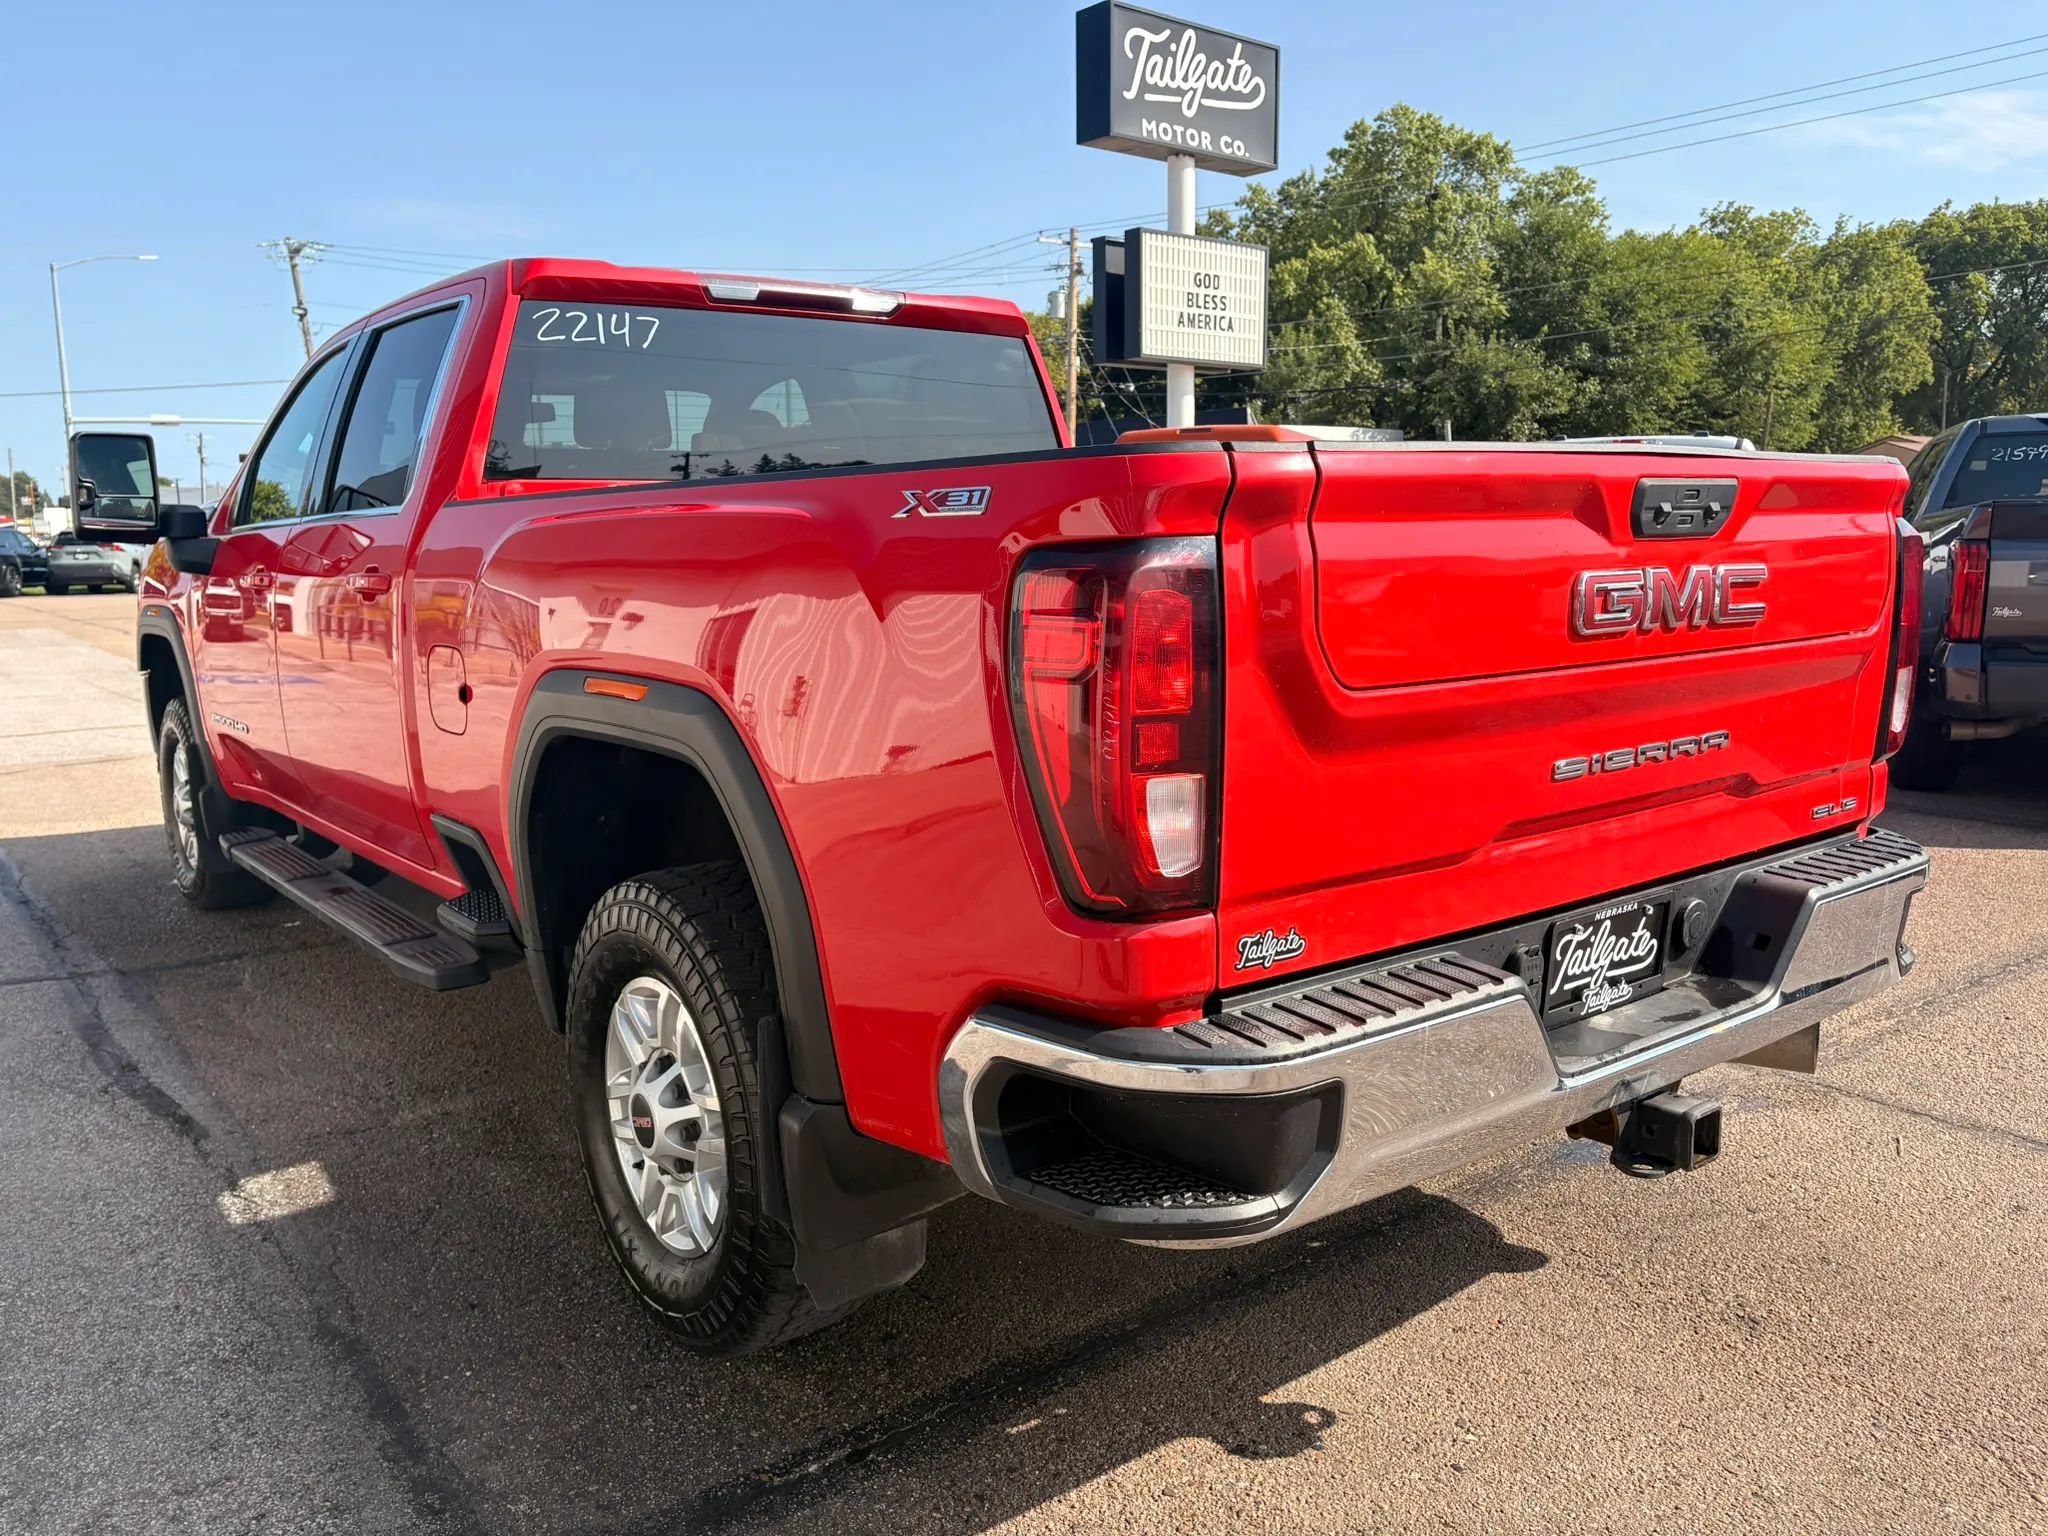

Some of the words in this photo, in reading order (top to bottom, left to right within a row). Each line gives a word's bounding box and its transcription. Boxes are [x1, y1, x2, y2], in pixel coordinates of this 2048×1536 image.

[1122, 27, 1266, 118] Tailgate
[1141, 118, 1213, 151] MOTOR
[1219, 135, 1250, 157] CO.
[1194, 272, 1220, 291] GOD
[1186, 291, 1228, 311] BLESS
[532, 308, 660, 349] 22147
[1177, 311, 1234, 333] AMERICA
[890, 486, 992, 518] X31
[1574, 564, 1768, 637] GMC
[1551, 730, 1730, 782] SIERRA
[1811, 797, 1857, 820] SLE
[1594, 902, 1638, 921] NEBRASKA
[1236, 928, 1306, 969] Tailgate
[1550, 916, 1658, 990] Tailgate
[1580, 978, 1633, 1016] Tailgate
